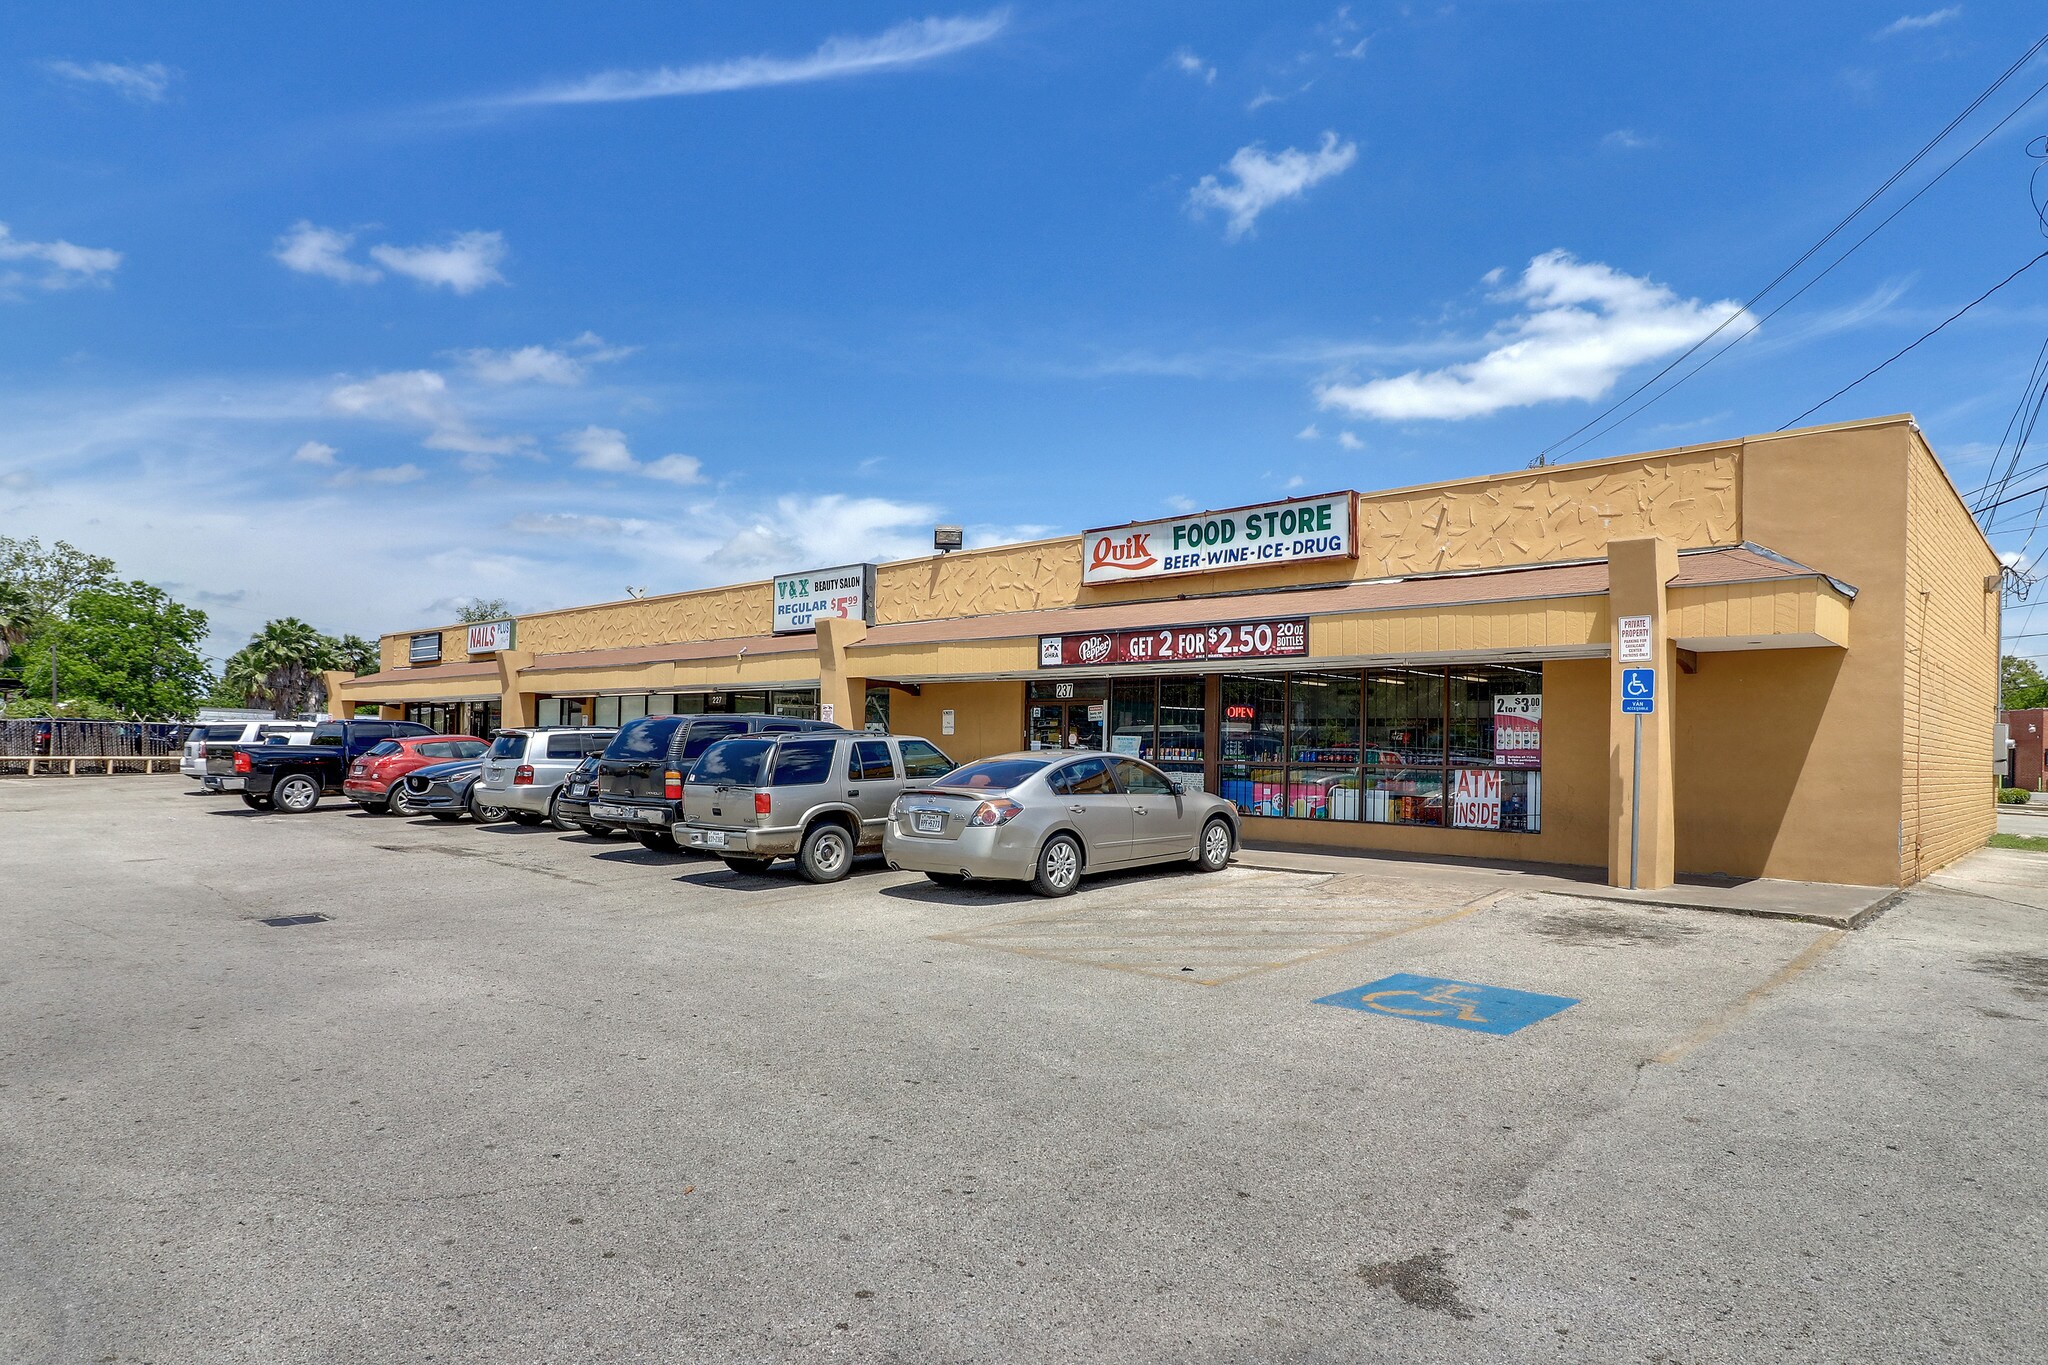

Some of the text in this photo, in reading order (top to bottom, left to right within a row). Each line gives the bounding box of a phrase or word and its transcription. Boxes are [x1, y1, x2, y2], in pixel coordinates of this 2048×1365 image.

[1173, 503, 1332, 551] FOOD STORE
[814, 575, 860, 592] BEAUTY SALON
[778, 600, 827, 615] REGULAR
[791, 614, 812, 626] CUT
[1624, 619, 1646, 628] PRIVATE
[497, 622, 510, 634] PLUS
[1621, 628, 1649, 638] PROPERTY
[470, 625, 496, 649] NAILS
[1090, 636, 1102, 648] Dr
[1130, 623, 1273, 657] GET 2 FOR $2.50
[1276, 635, 1304, 647] BOTTLES
[1079, 640, 1109, 661] Pepper
[1056, 684, 1073, 698] 237
[1227, 705, 1254, 718] OPEN
[1497, 698, 1505, 713] 2
[1505, 705, 1517, 713] for
[1456, 769, 1500, 799] ATM
[1455, 802, 1499, 825] INSIDE
